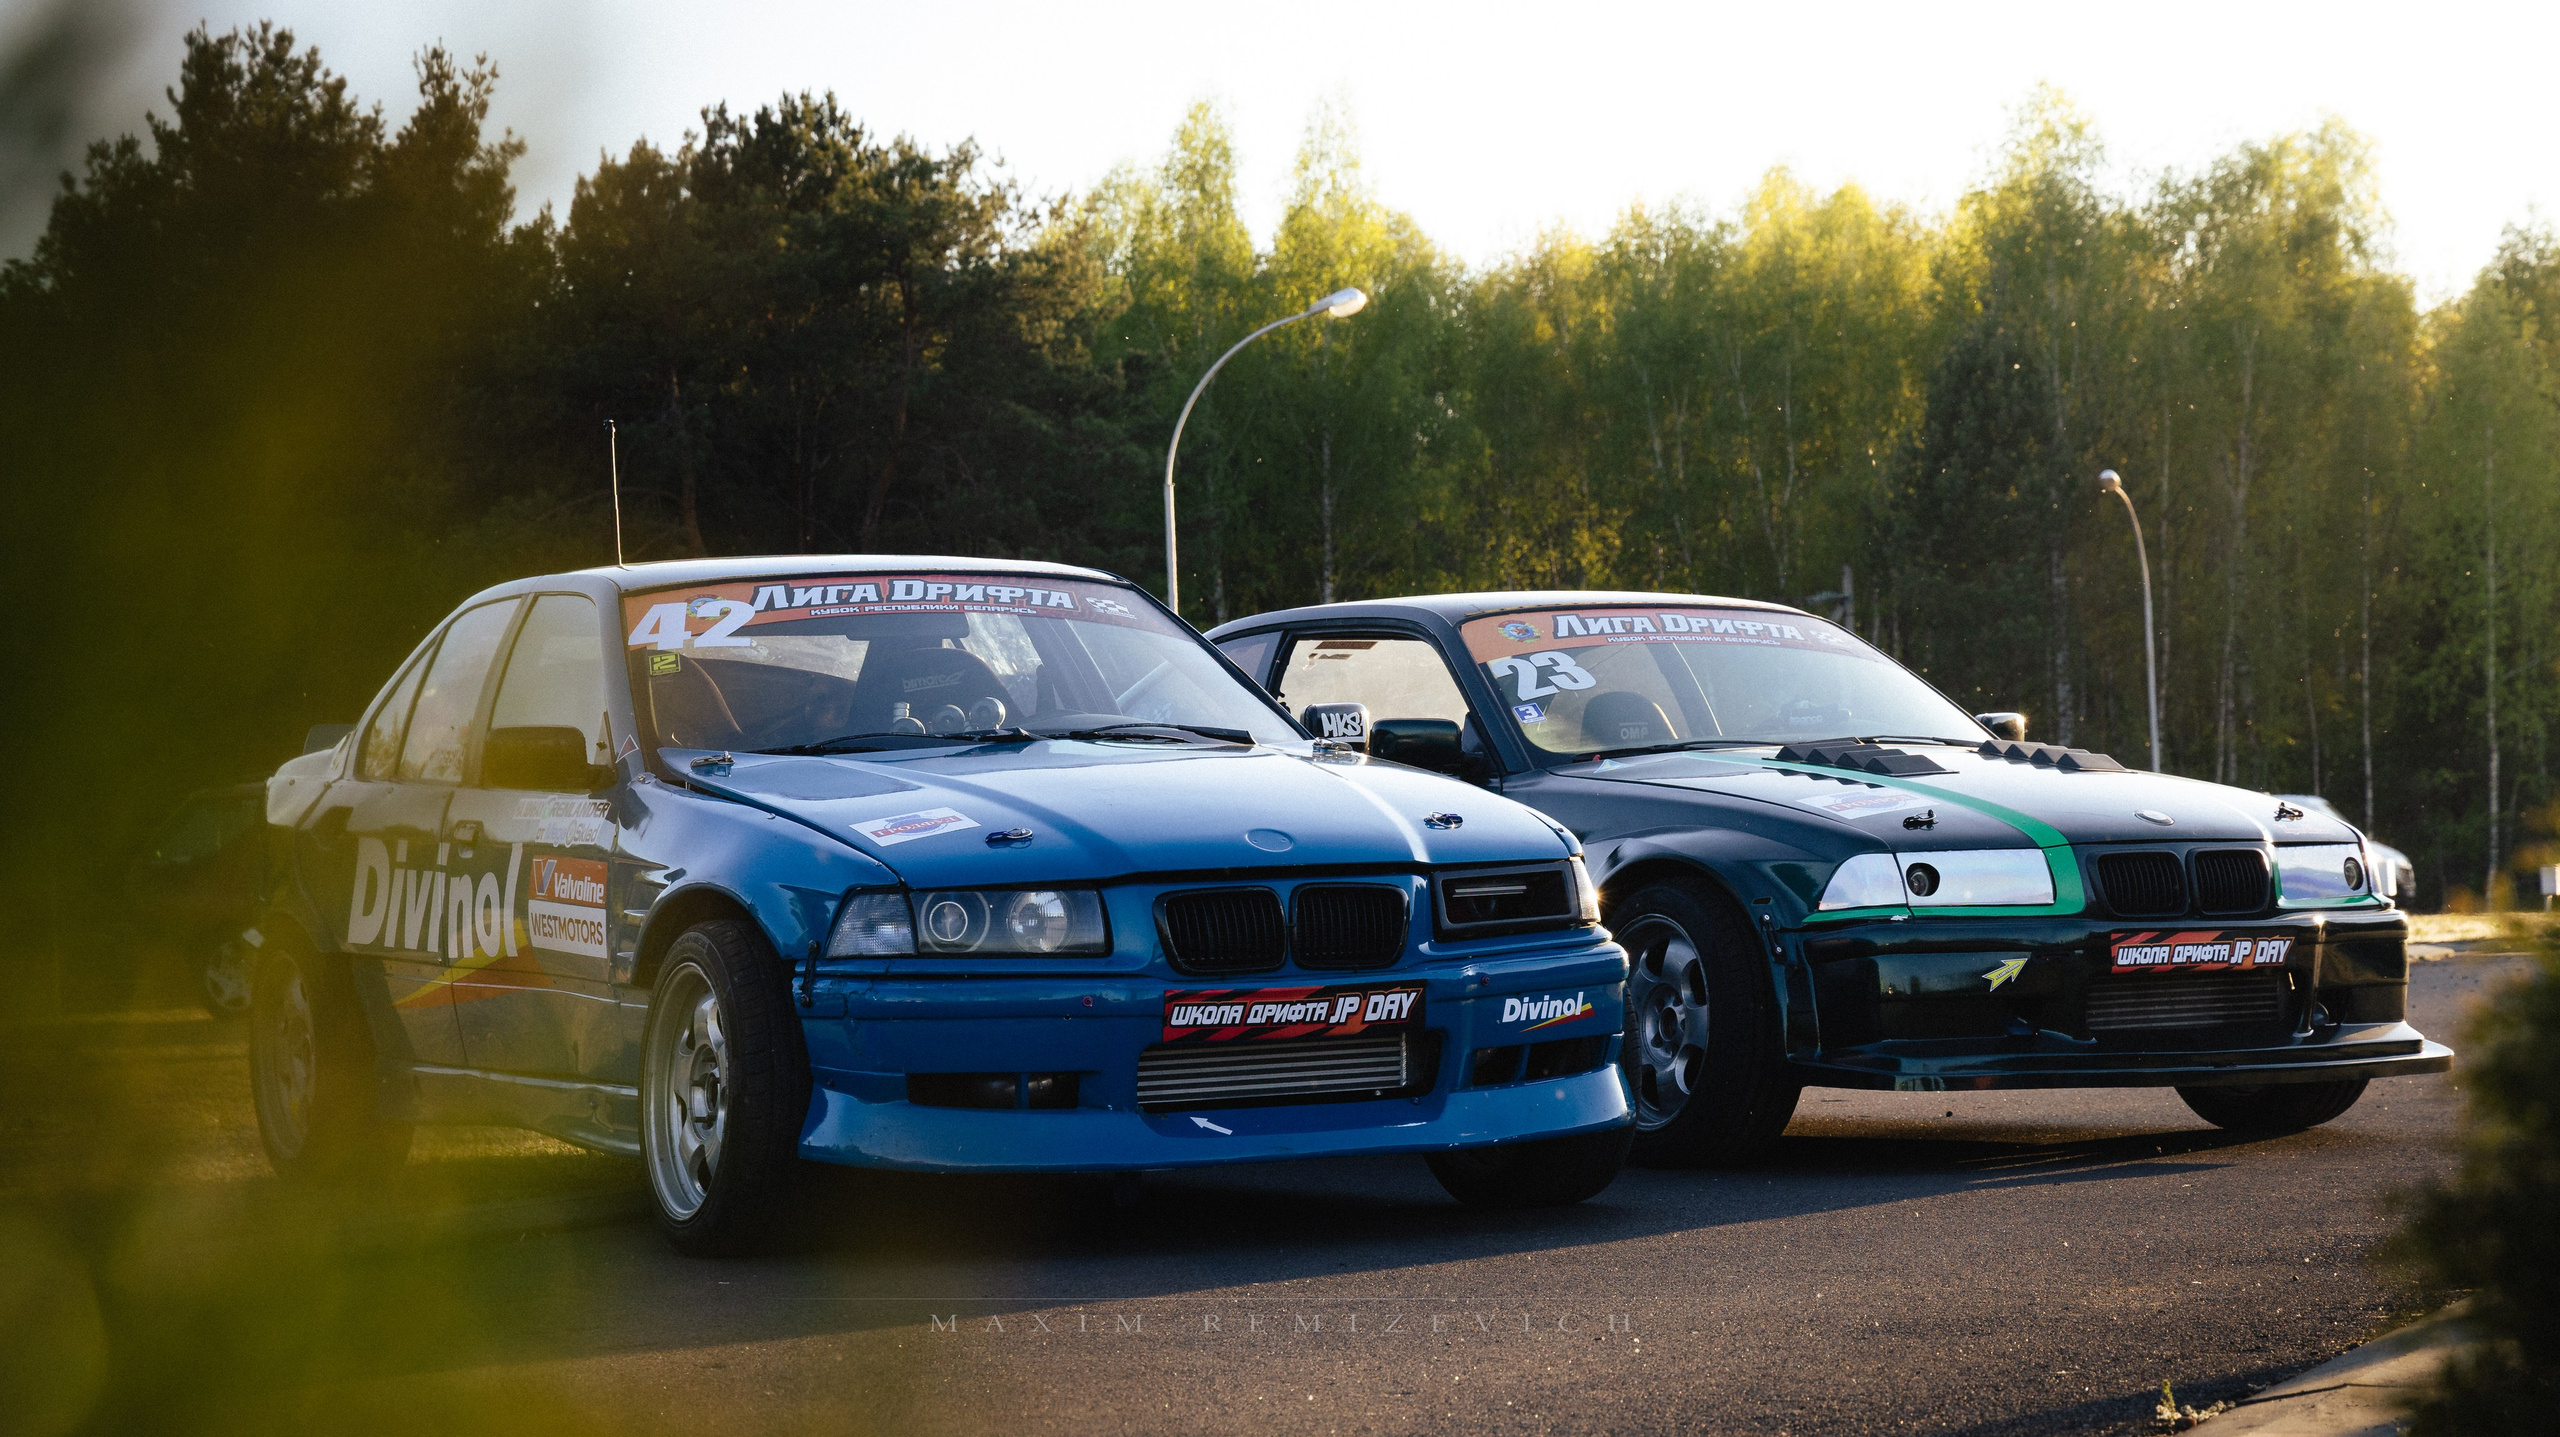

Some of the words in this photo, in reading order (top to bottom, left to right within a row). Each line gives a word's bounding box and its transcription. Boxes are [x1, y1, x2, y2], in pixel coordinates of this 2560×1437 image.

[628, 600, 755, 650] 42
[810, 605, 859, 616] КУБОК
[864, 604, 958, 613] РЕСПУБЛИКИ
[963, 605, 1036, 615] БЕЛАРУСЬ
[1492, 651, 1597, 701] 23
[1518, 705, 1539, 720] 3
[1620, 727, 1649, 740] OMP
[347, 837, 523, 958] Divinol
[554, 872, 604, 904] Valvoline
[530, 912, 604, 946] WESTMOTORS
[2117, 946, 2170, 965] ШКОЛА
[2172, 943, 2231, 963] ДРИФТА
[2230, 941, 2253, 964] JP
[2254, 940, 2291, 963] DAY
[1170, 1004, 1244, 1026] ШКОЛА
[1247, 1001, 1330, 1024] ДРИФТА
[1329, 996, 1360, 1024] JP
[1364, 992, 1417, 1022] DAY
[1502, 991, 1584, 1023] Divinol
